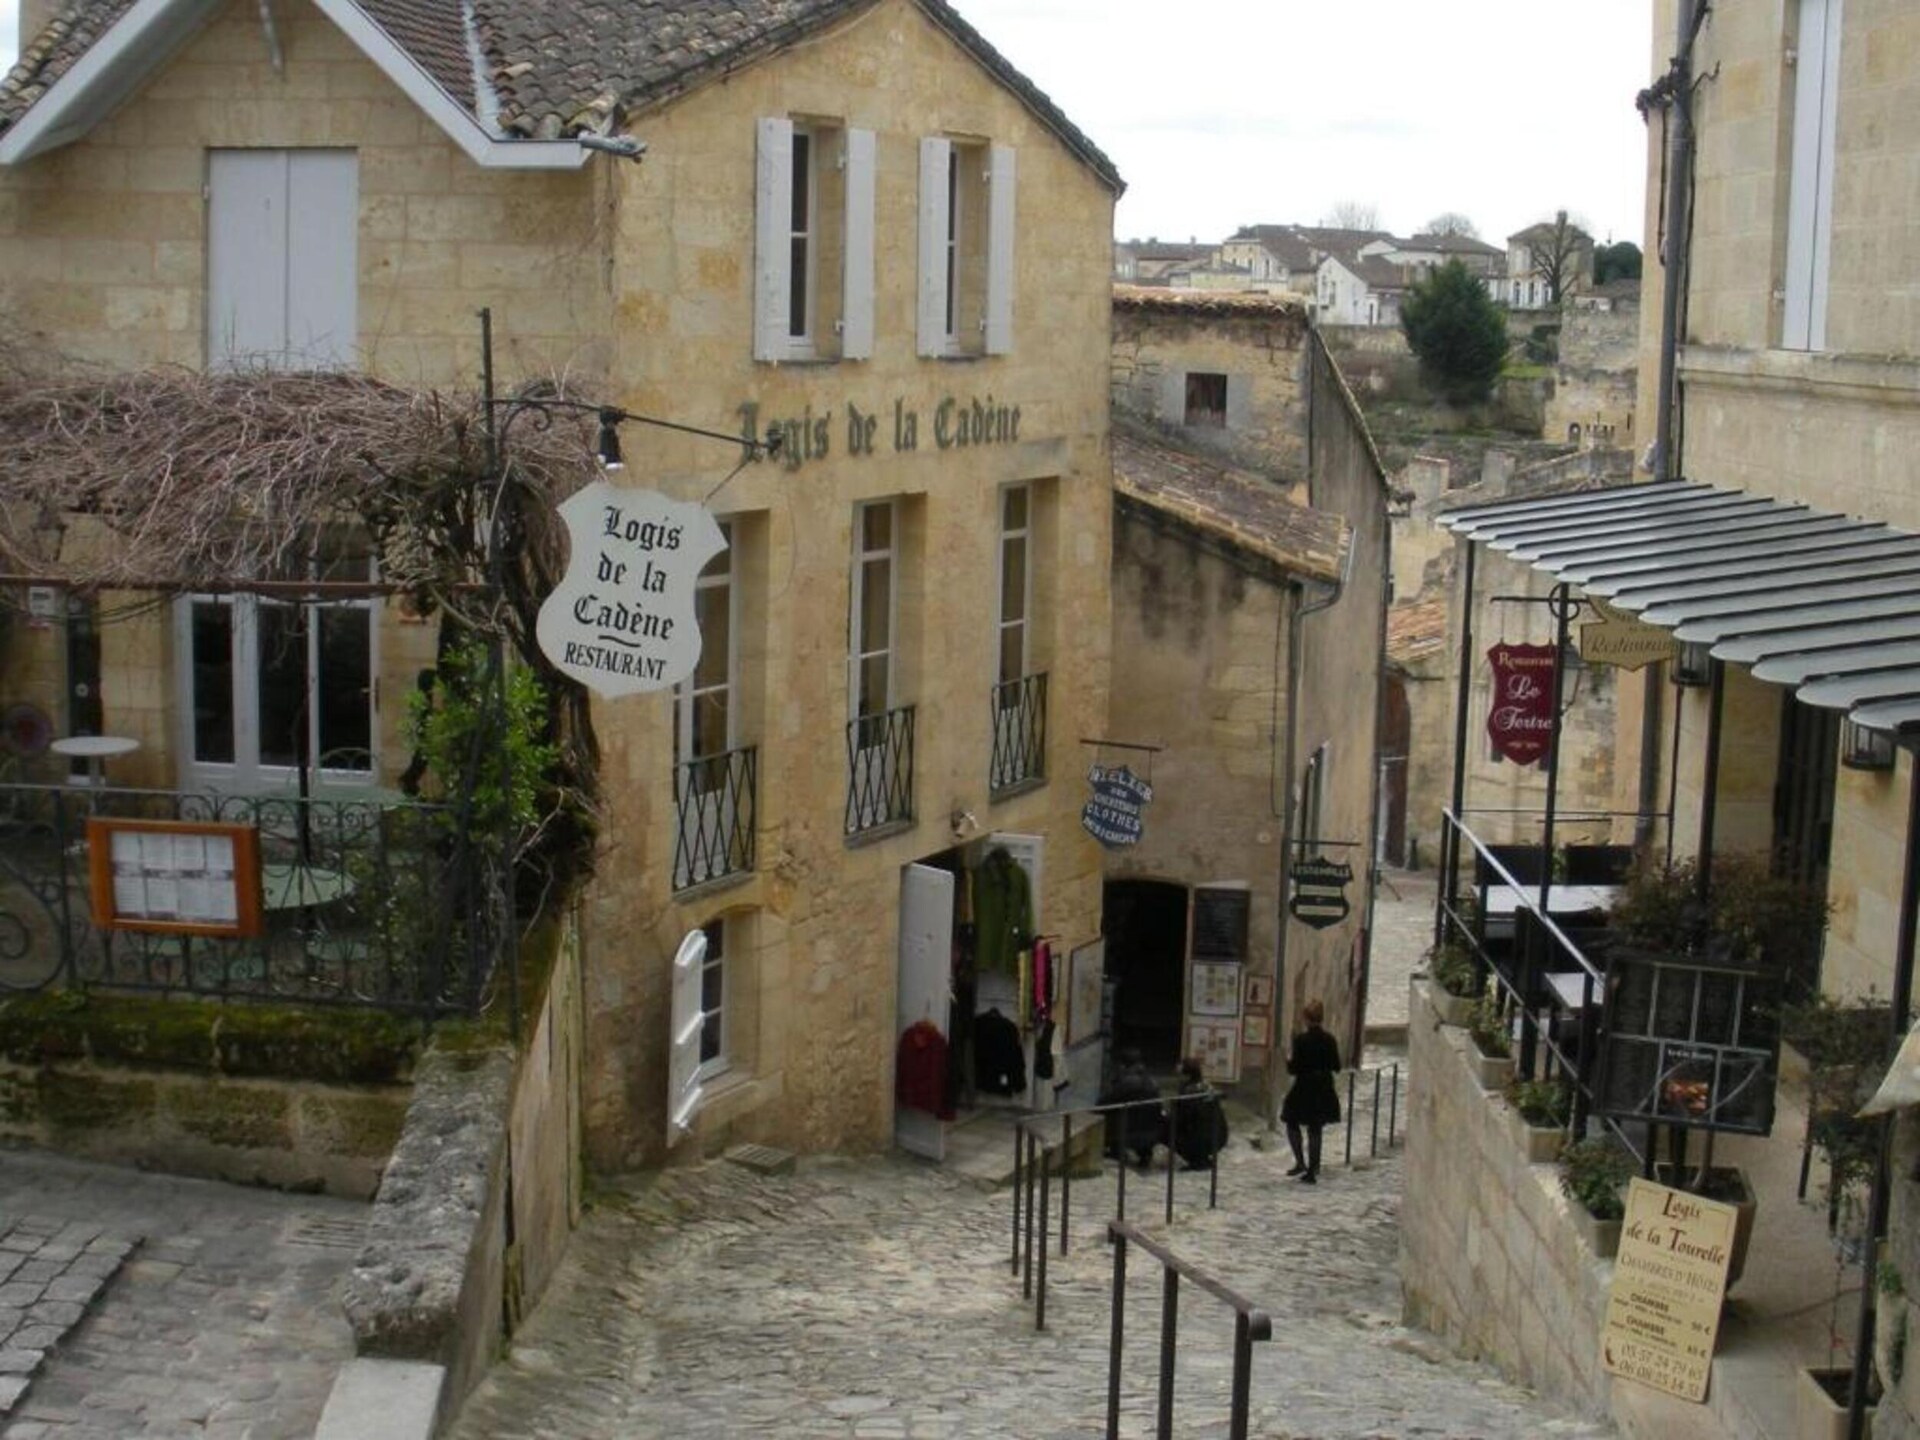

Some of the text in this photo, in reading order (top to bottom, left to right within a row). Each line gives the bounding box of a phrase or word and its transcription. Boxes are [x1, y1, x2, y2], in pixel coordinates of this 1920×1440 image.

[848, 401, 877, 456] de
[895, 397, 917, 450] la
[603, 505, 684, 551] Logis
[597, 551, 667, 593] de la
[573, 594, 674, 641] Cadène
[563, 641, 667, 681] RESTAURANT
[1086, 804, 1140, 832] CLOTHES
[1662, 1192, 1702, 1221] Logis
[1626, 1220, 1725, 1265] de la Tourelle
